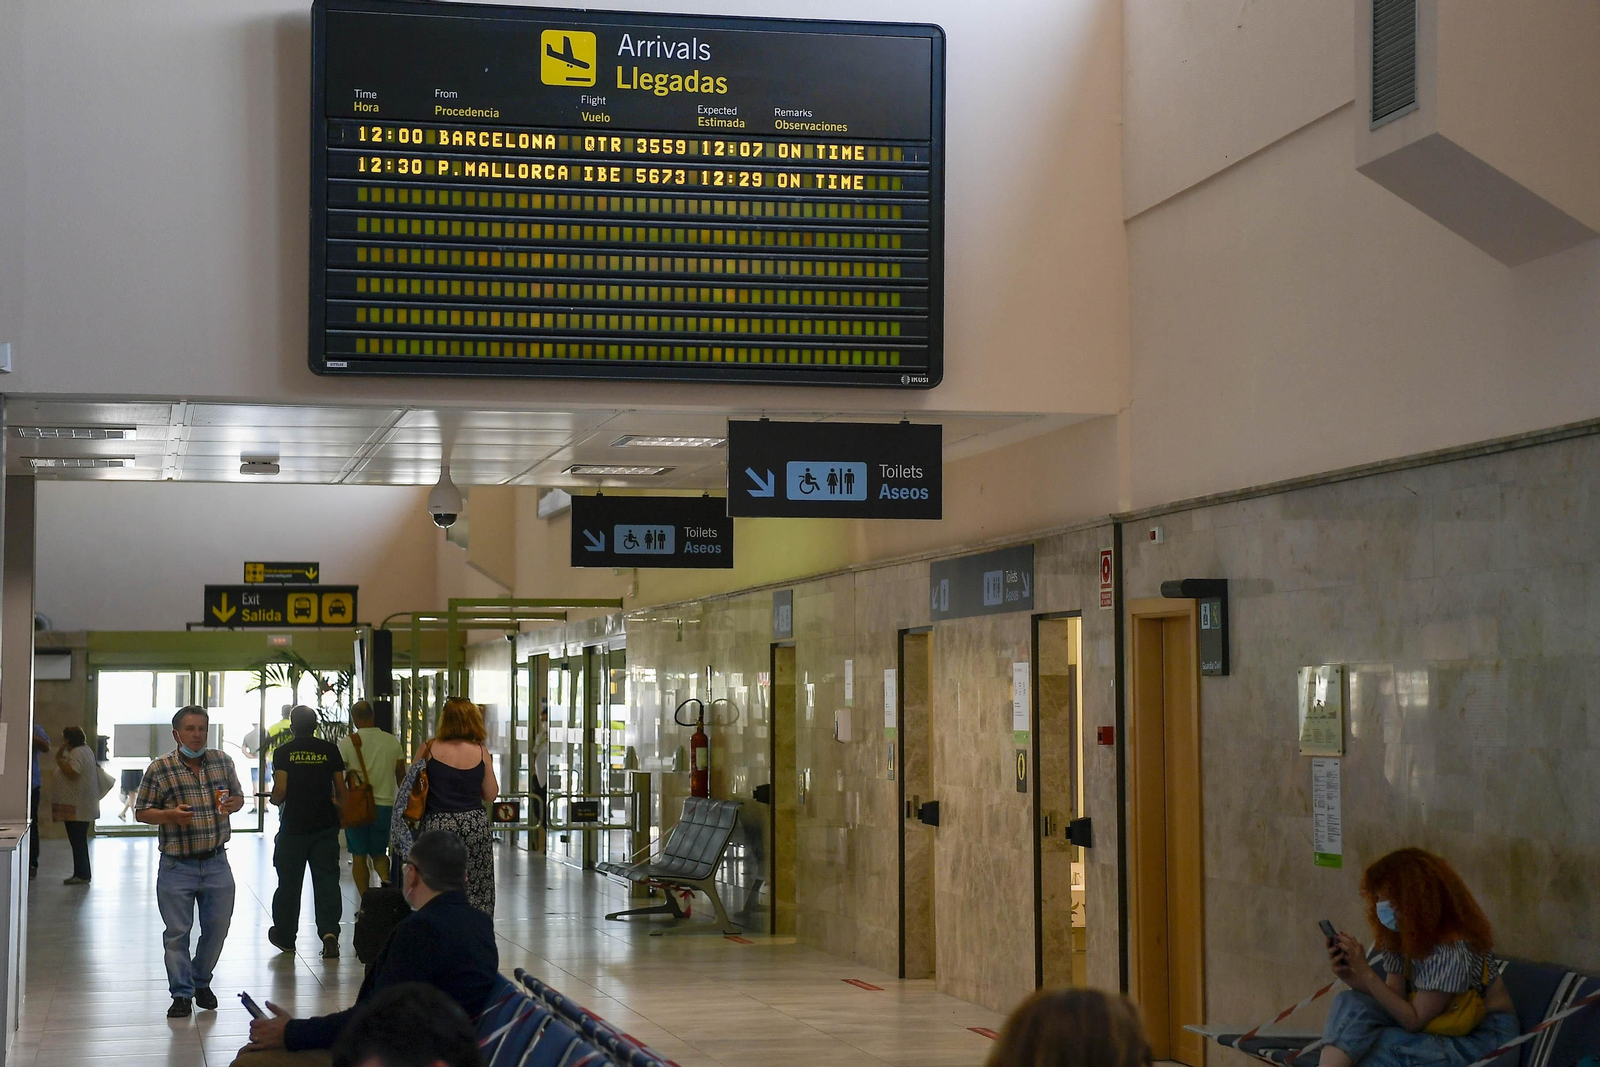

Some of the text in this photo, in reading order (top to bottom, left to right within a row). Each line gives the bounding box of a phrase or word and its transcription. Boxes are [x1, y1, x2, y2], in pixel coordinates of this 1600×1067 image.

[618, 34, 710, 60] Arrivals
[617, 66, 727, 96] Llegadas
[354, 89, 377, 99] Time
[435, 89, 457, 98] From
[581, 95, 606, 106] Flight
[354, 102, 379, 112] Hora
[435, 106, 499, 117] Procedencia
[698, 105, 737, 118] Expected
[775, 108, 812, 117] Remarks
[582, 112, 610, 122] Vuelo
[698, 117, 745, 128] Estimada
[775, 120, 847, 131] Observaciones
[359, 126, 864, 160] 12:00 BARCELONA QTR 3559 12:07 ON TIME
[359, 157, 863, 189] 12:30 P.MALLORCA IBE 5673 12:29 ON TIME
[879, 465, 923, 478] Toilets
[879, 484, 928, 499] Aseos
[685, 527, 717, 537] Toilets
[684, 542, 721, 553] Aseos
[1006, 570, 1018, 583] Toilets
[242, 593, 259, 605] Exit
[242, 609, 281, 622] Salida
